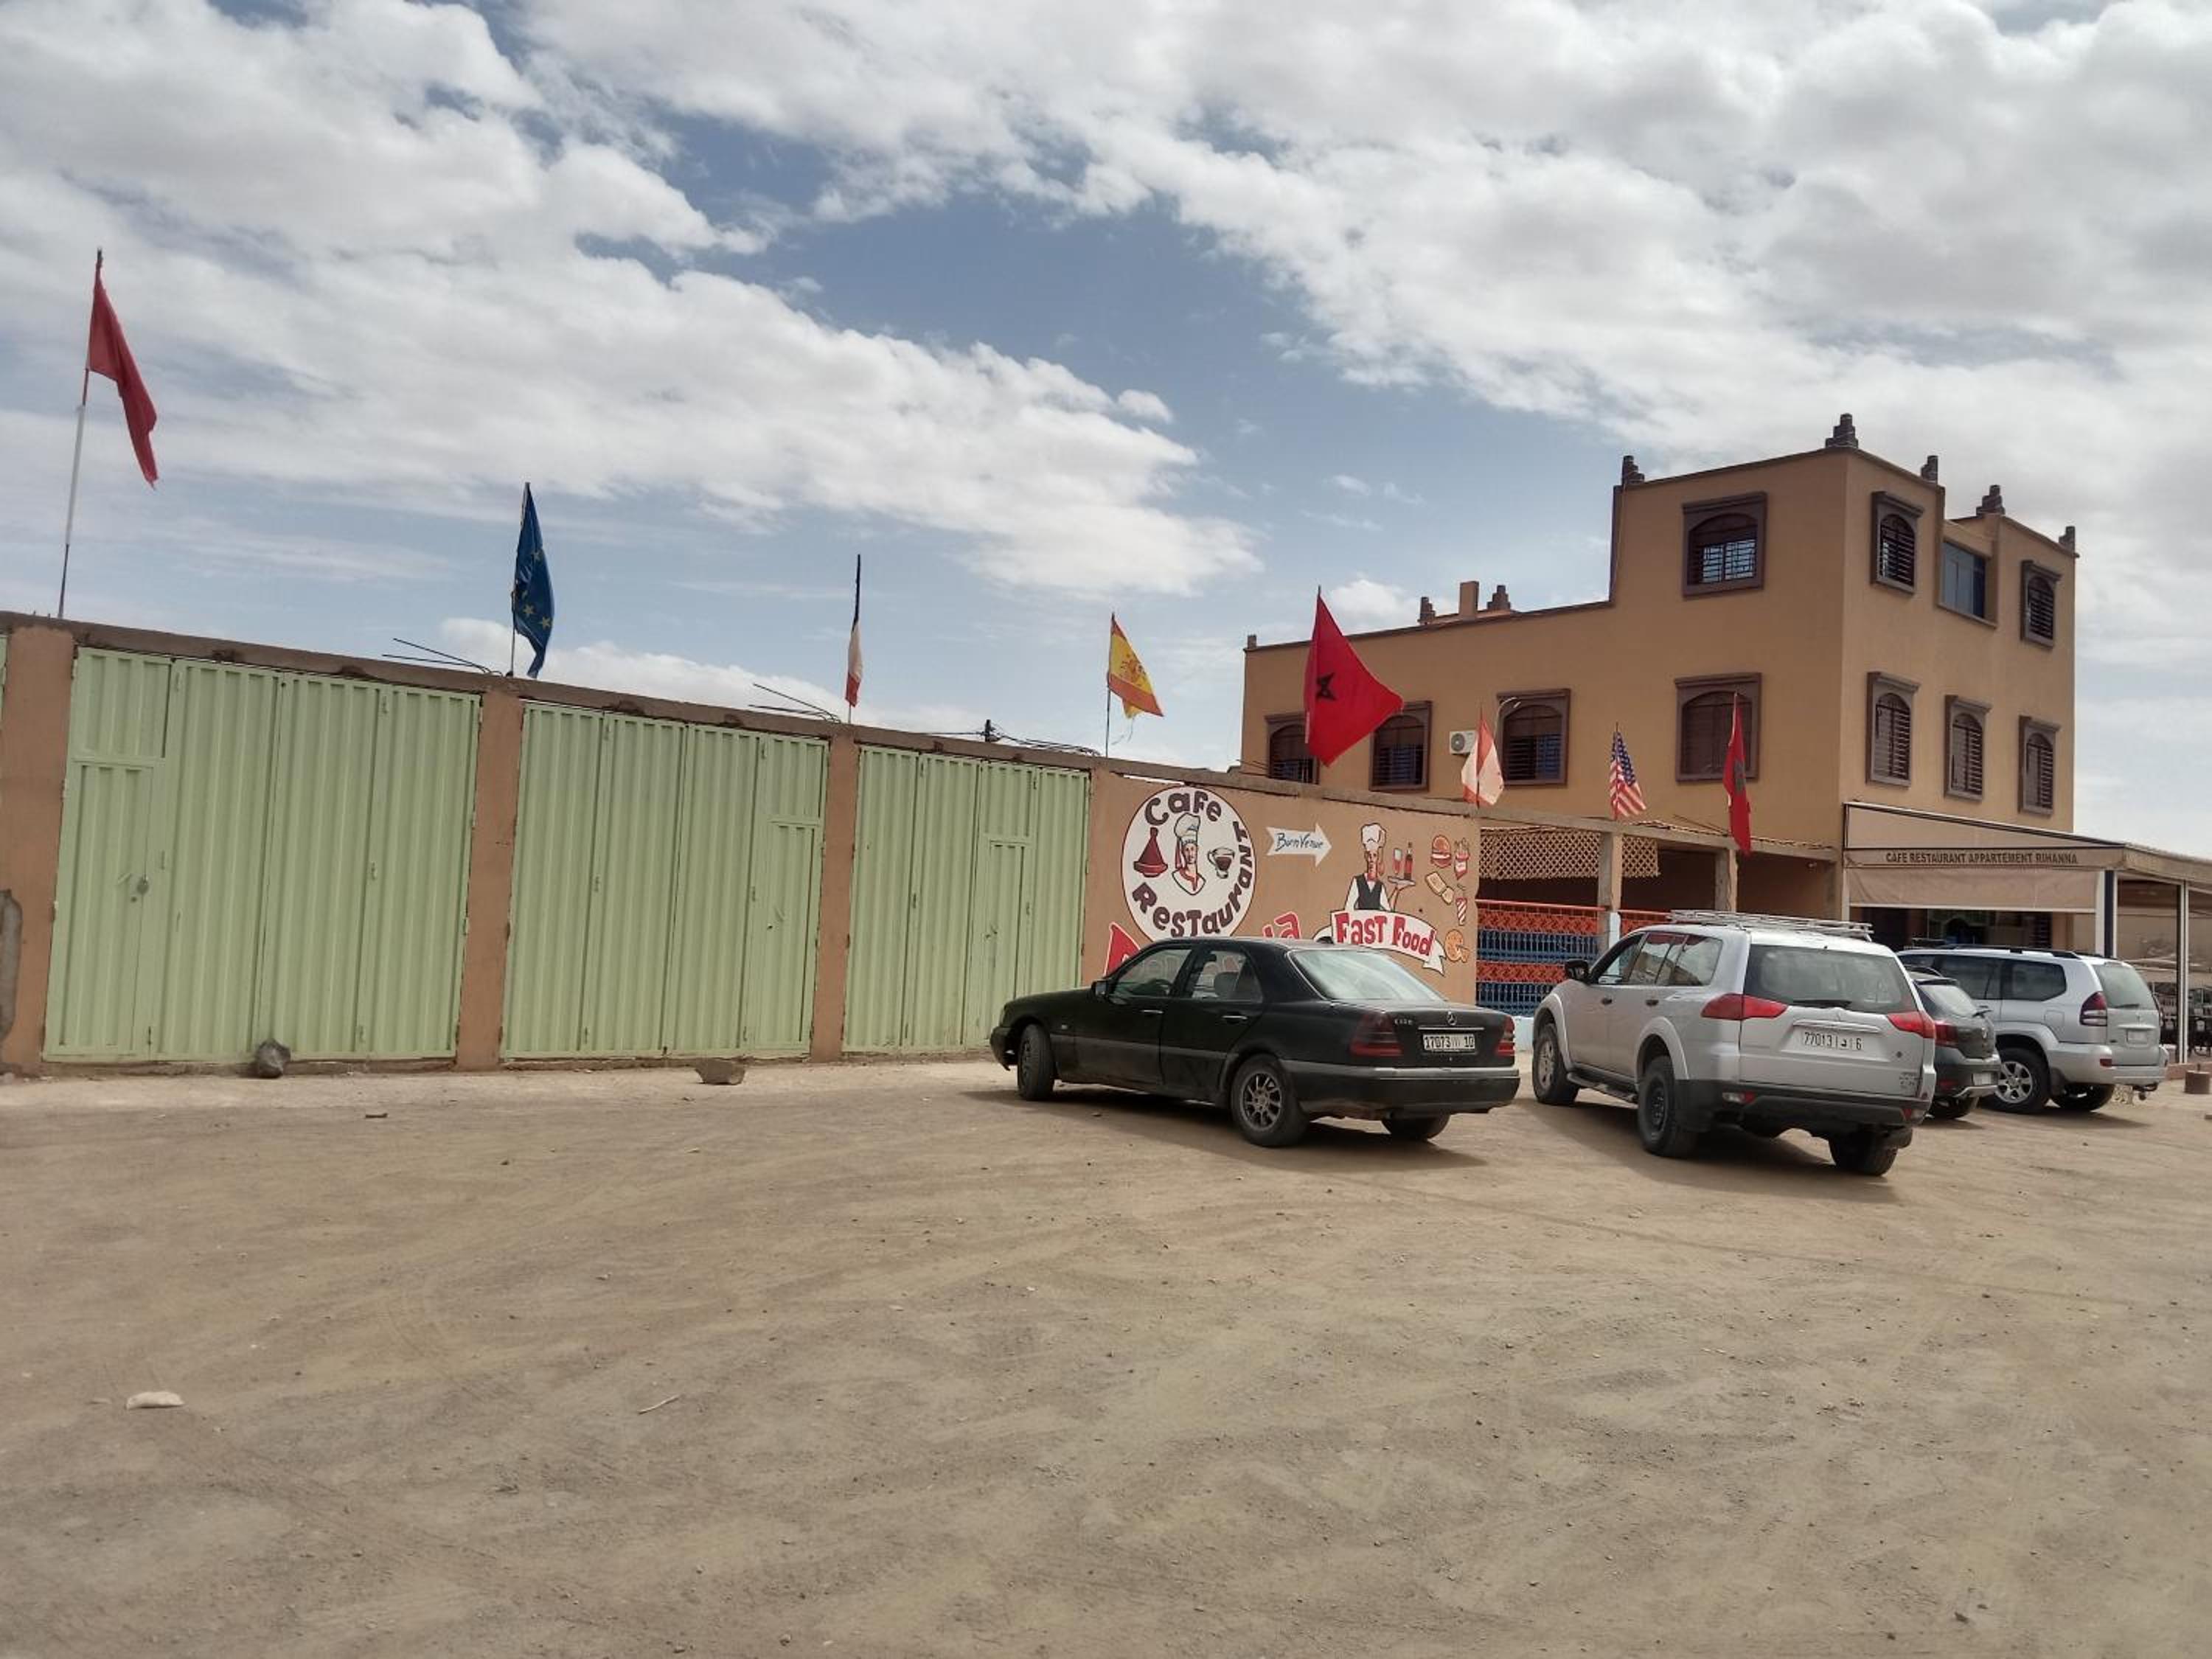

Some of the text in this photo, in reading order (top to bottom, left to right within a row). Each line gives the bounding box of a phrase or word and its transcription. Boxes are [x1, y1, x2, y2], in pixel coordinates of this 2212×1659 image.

[1886, 852, 1907, 863] CAFE
[1910, 852, 1965, 863] RESTAURANT
[1968, 853, 2033, 863] APPARTEMENT
[1392, 917, 1435, 956] Food
[1856, 1037, 1862, 1050] 6
